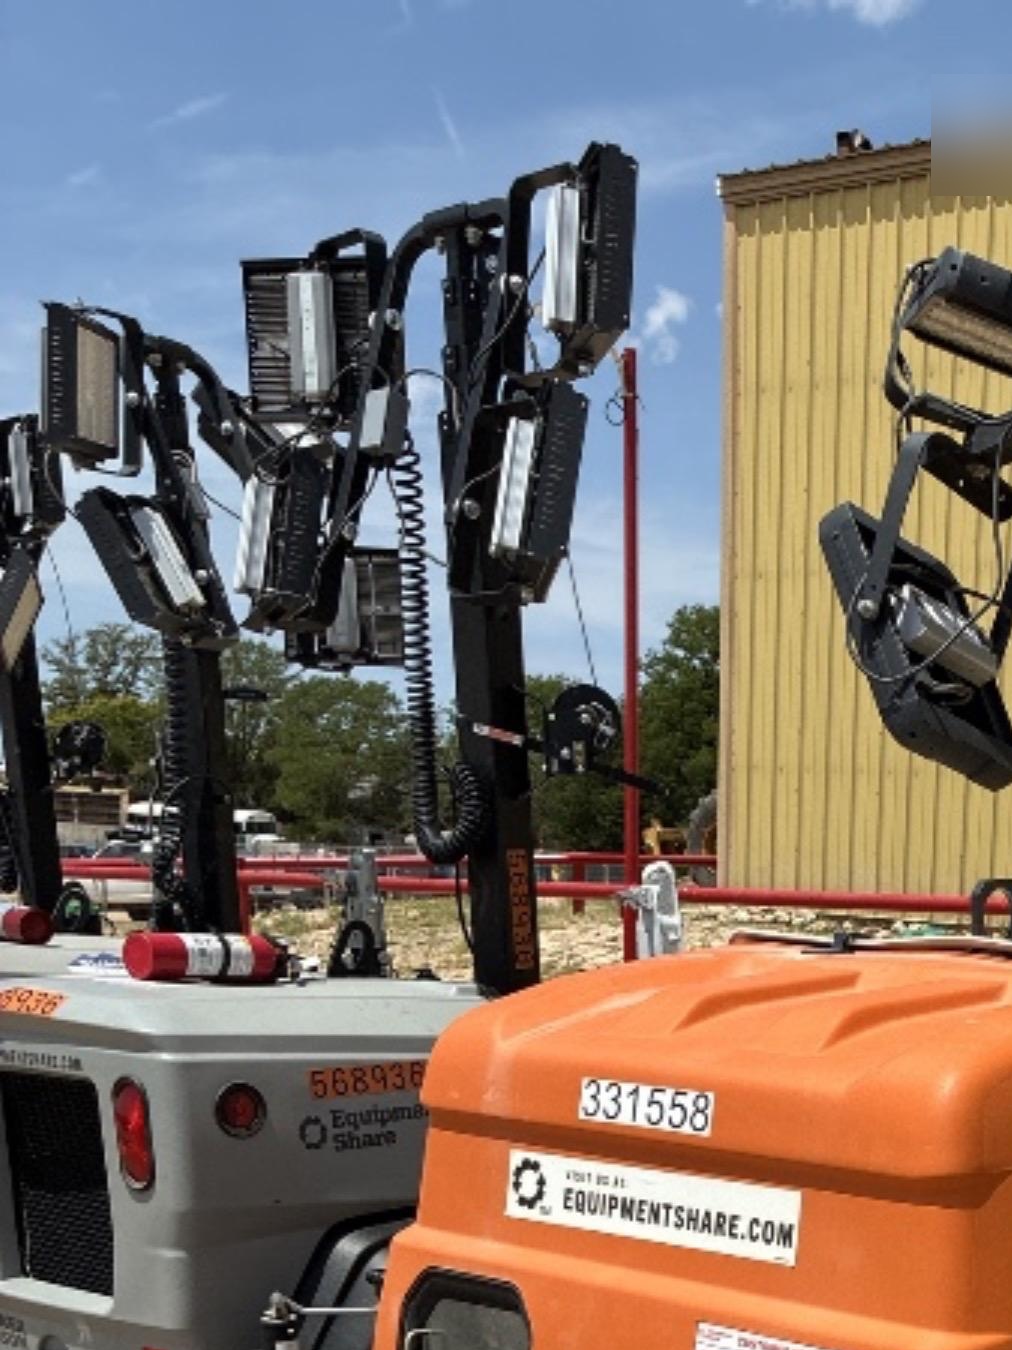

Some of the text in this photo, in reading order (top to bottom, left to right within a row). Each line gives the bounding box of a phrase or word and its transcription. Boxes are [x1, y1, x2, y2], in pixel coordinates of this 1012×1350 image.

[581, 1079, 711, 1133] 331558
[332, 1130, 398, 1153] Share
[562, 1186, 796, 1250] EQUIPMENTSHARE.COM
